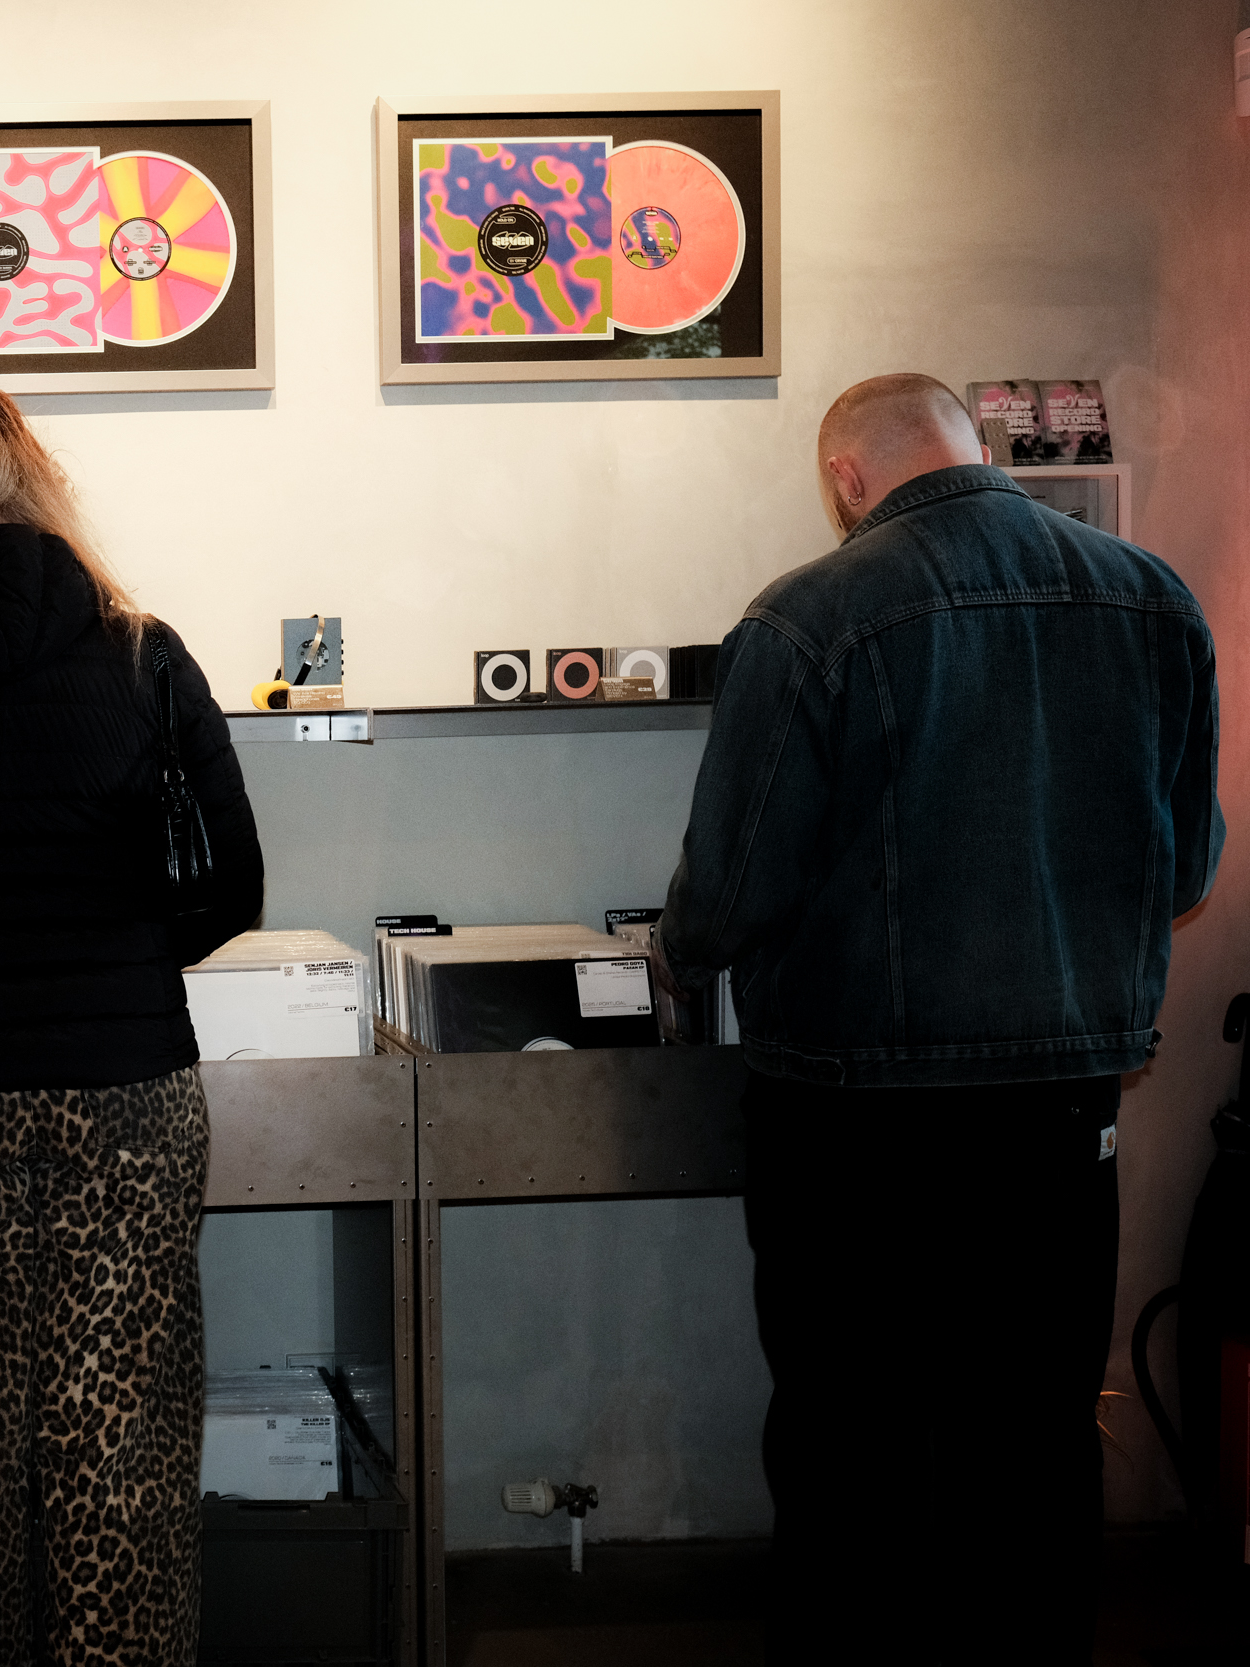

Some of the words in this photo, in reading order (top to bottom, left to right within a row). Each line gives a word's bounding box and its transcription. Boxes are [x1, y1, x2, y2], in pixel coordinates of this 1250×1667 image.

[981, 410, 1033, 419] RECORD
[1049, 408, 1101, 416] RECORD
[1050, 416, 1102, 425] STORE
[1052, 424, 1103, 433] OPENING
